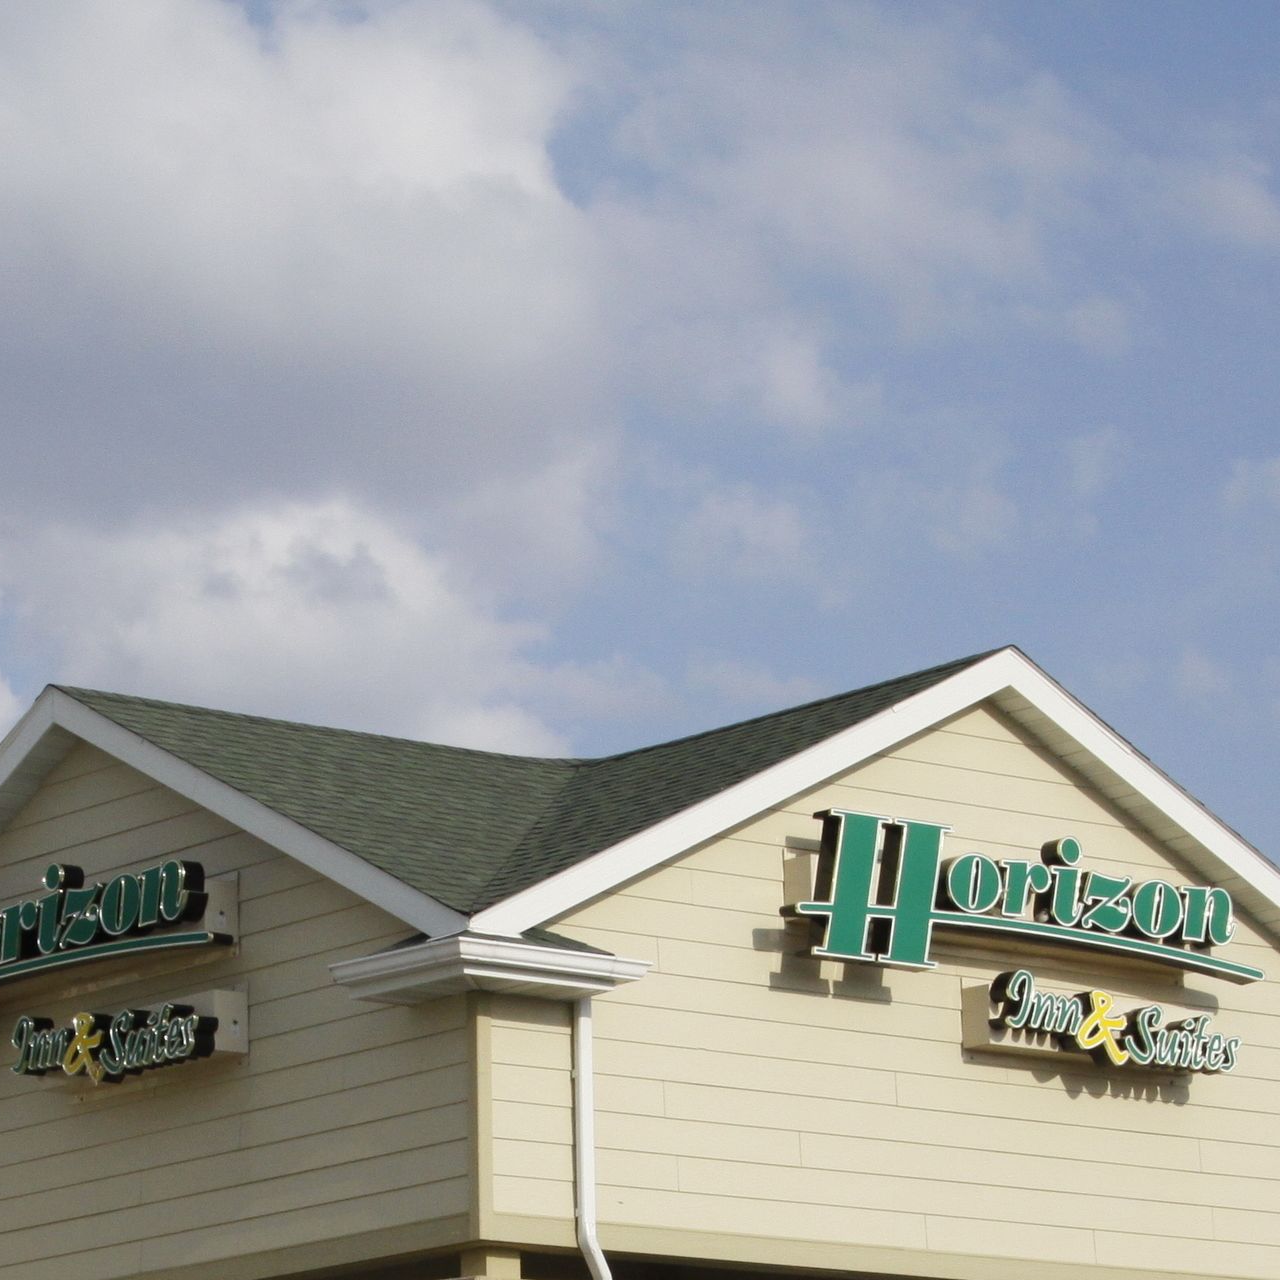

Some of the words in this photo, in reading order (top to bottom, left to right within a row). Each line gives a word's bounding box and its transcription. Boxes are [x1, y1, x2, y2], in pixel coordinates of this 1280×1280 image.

[797, 807, 1252, 970] Horizon
[10, 1015, 68, 1075] Inn
[62, 1011, 104, 1085] &
[99, 1003, 200, 1075] Suites
[1003, 969, 1082, 1034] Inn
[1076, 989, 1129, 1066] &
[1124, 1004, 1242, 1073] Suites
